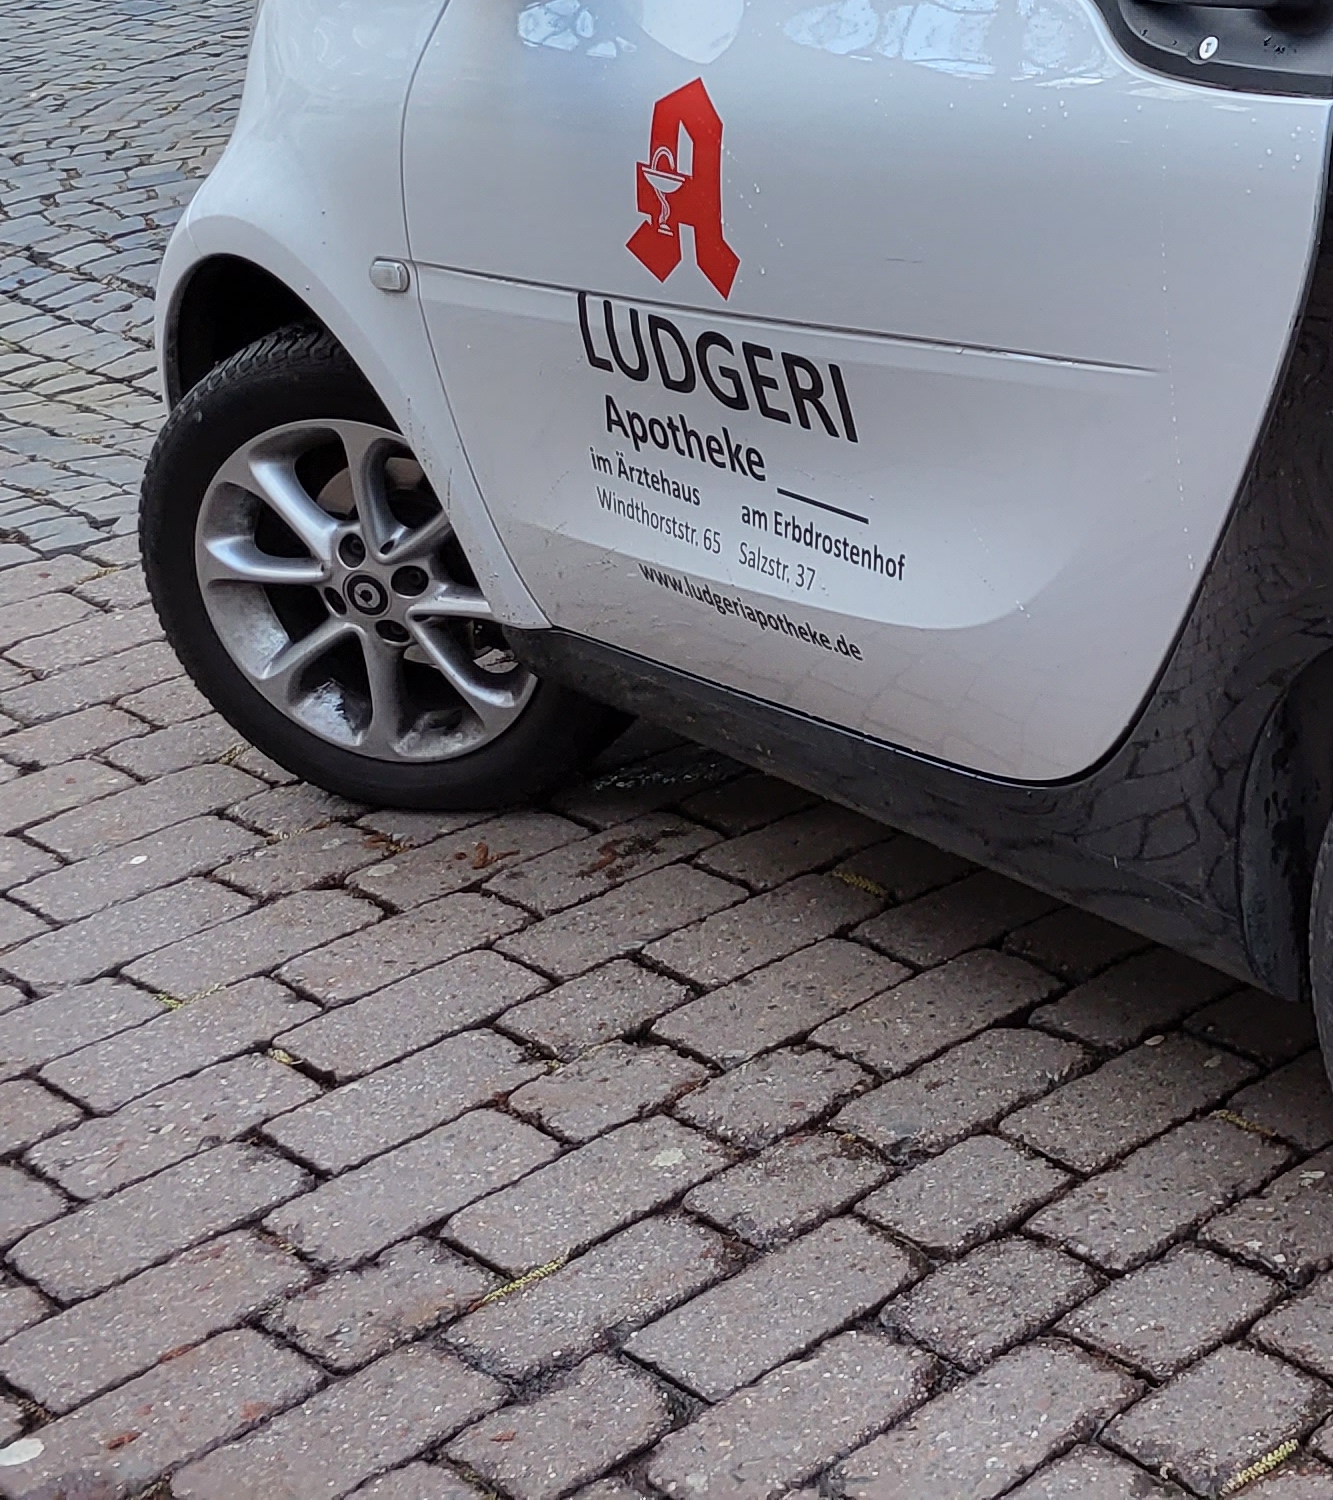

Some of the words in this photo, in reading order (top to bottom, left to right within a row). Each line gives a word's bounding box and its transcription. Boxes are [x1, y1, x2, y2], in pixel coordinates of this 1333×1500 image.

[577, 291, 859, 444] LUDGERI
[604, 393, 767, 482] Apotheke
[589, 446, 614, 476] im
[617, 451, 701, 507] Ärztehaus
[596, 485, 700, 547] Windthorststr.
[703, 527, 721, 555] 65
[741, 504, 769, 529] am
[774, 510, 906, 581] Erbdrostenhof
[738, 541, 790, 584] Salzstr.
[795, 563, 816, 592] 37
[638, 562, 864, 661] www.ludgeriapotheke.de
